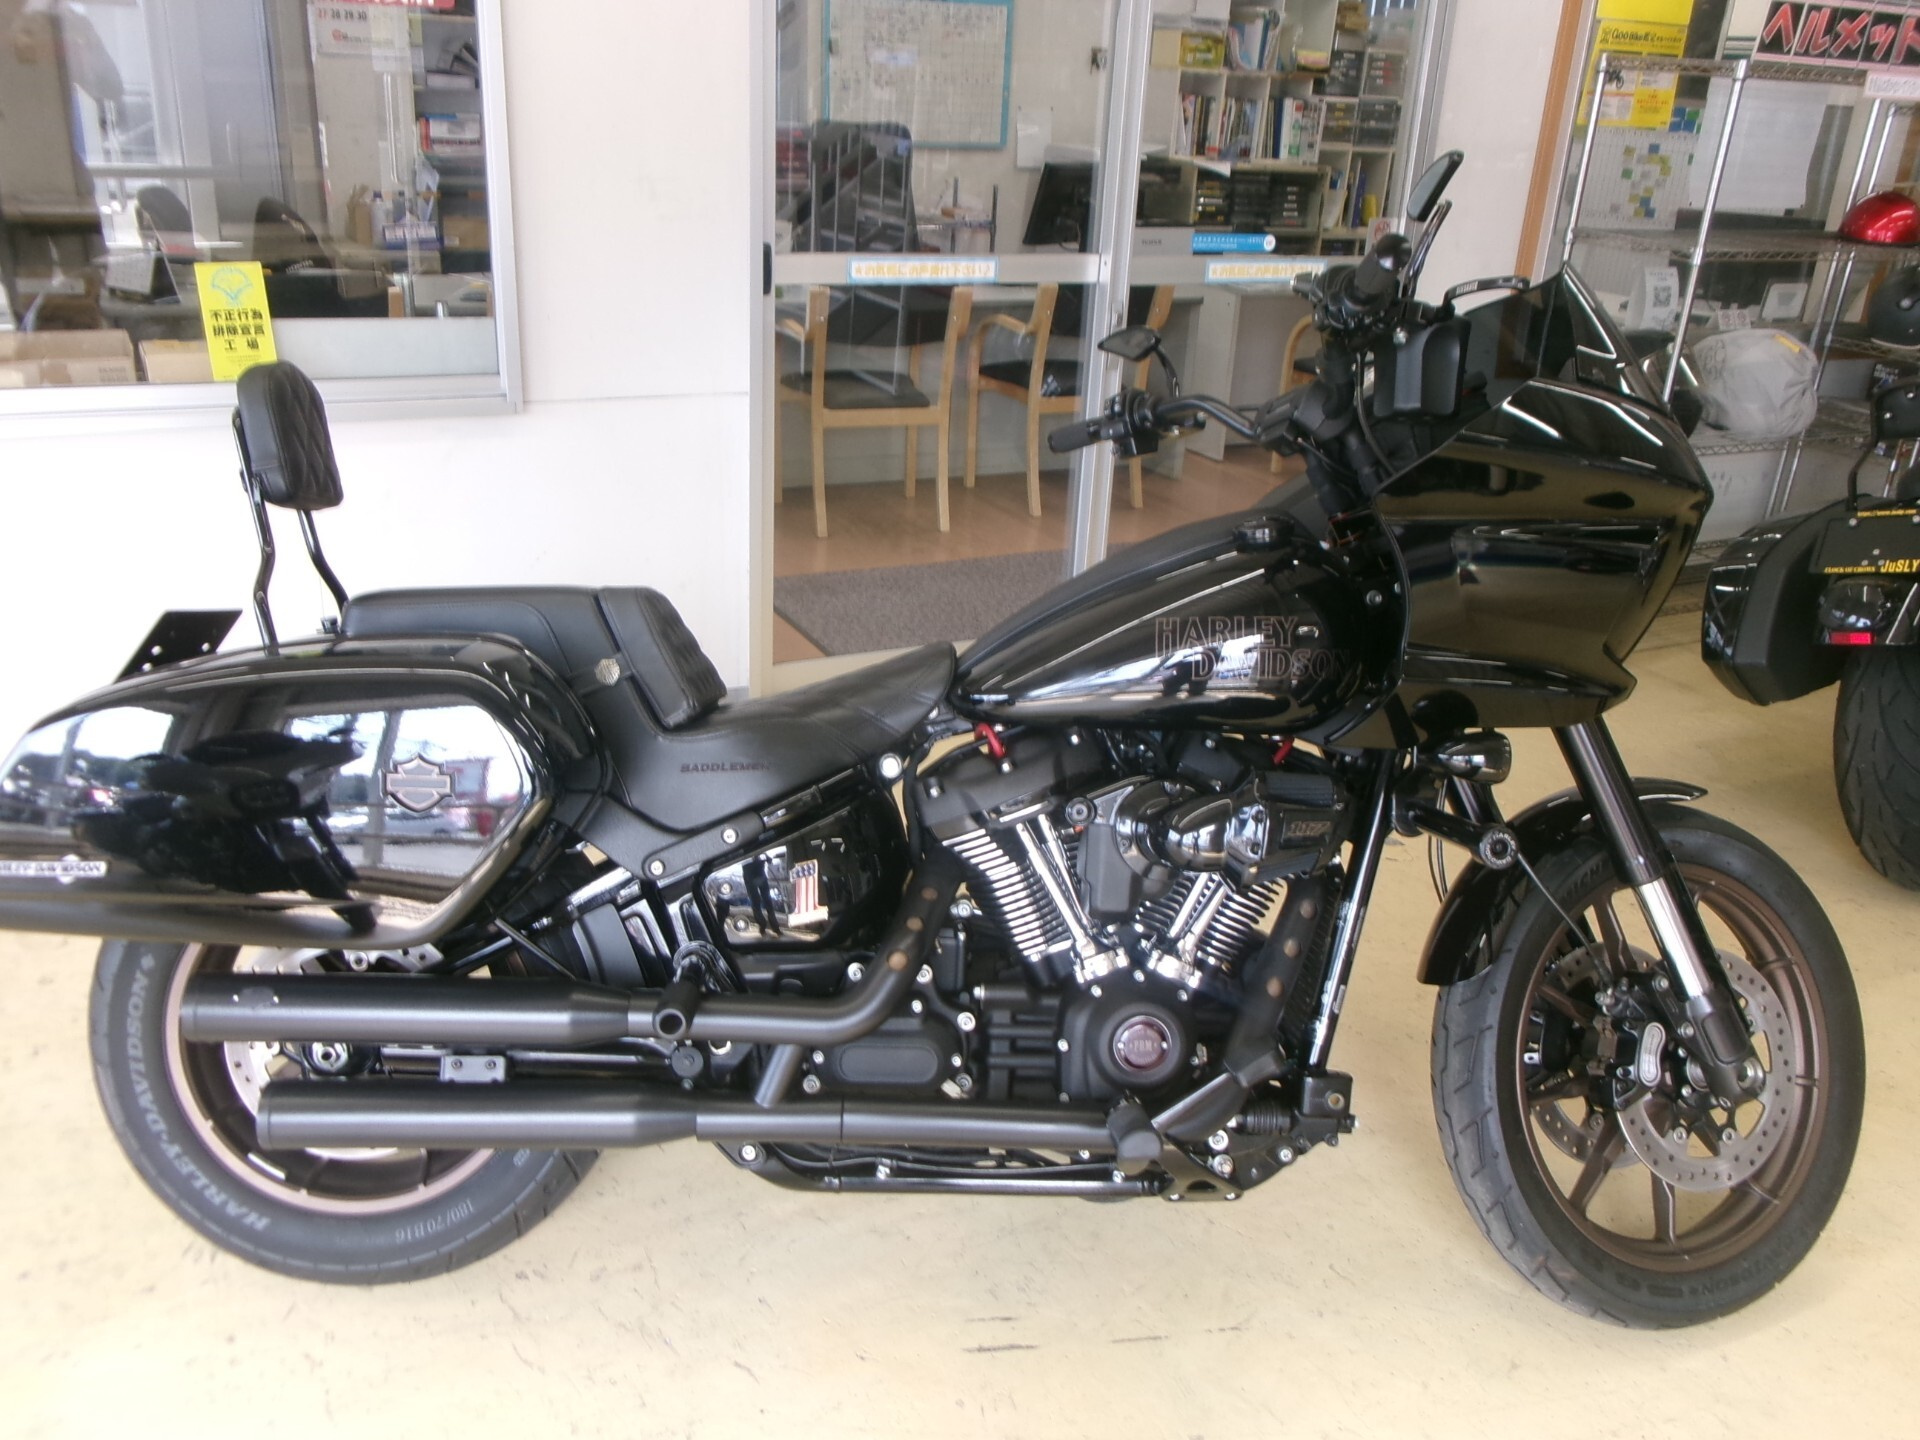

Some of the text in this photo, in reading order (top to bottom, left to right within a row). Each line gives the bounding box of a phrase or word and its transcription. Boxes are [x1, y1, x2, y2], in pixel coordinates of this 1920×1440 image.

[1763, 3, 1920, 63] ヘルメット
[1155, 615, 1298, 658] HARLEY
